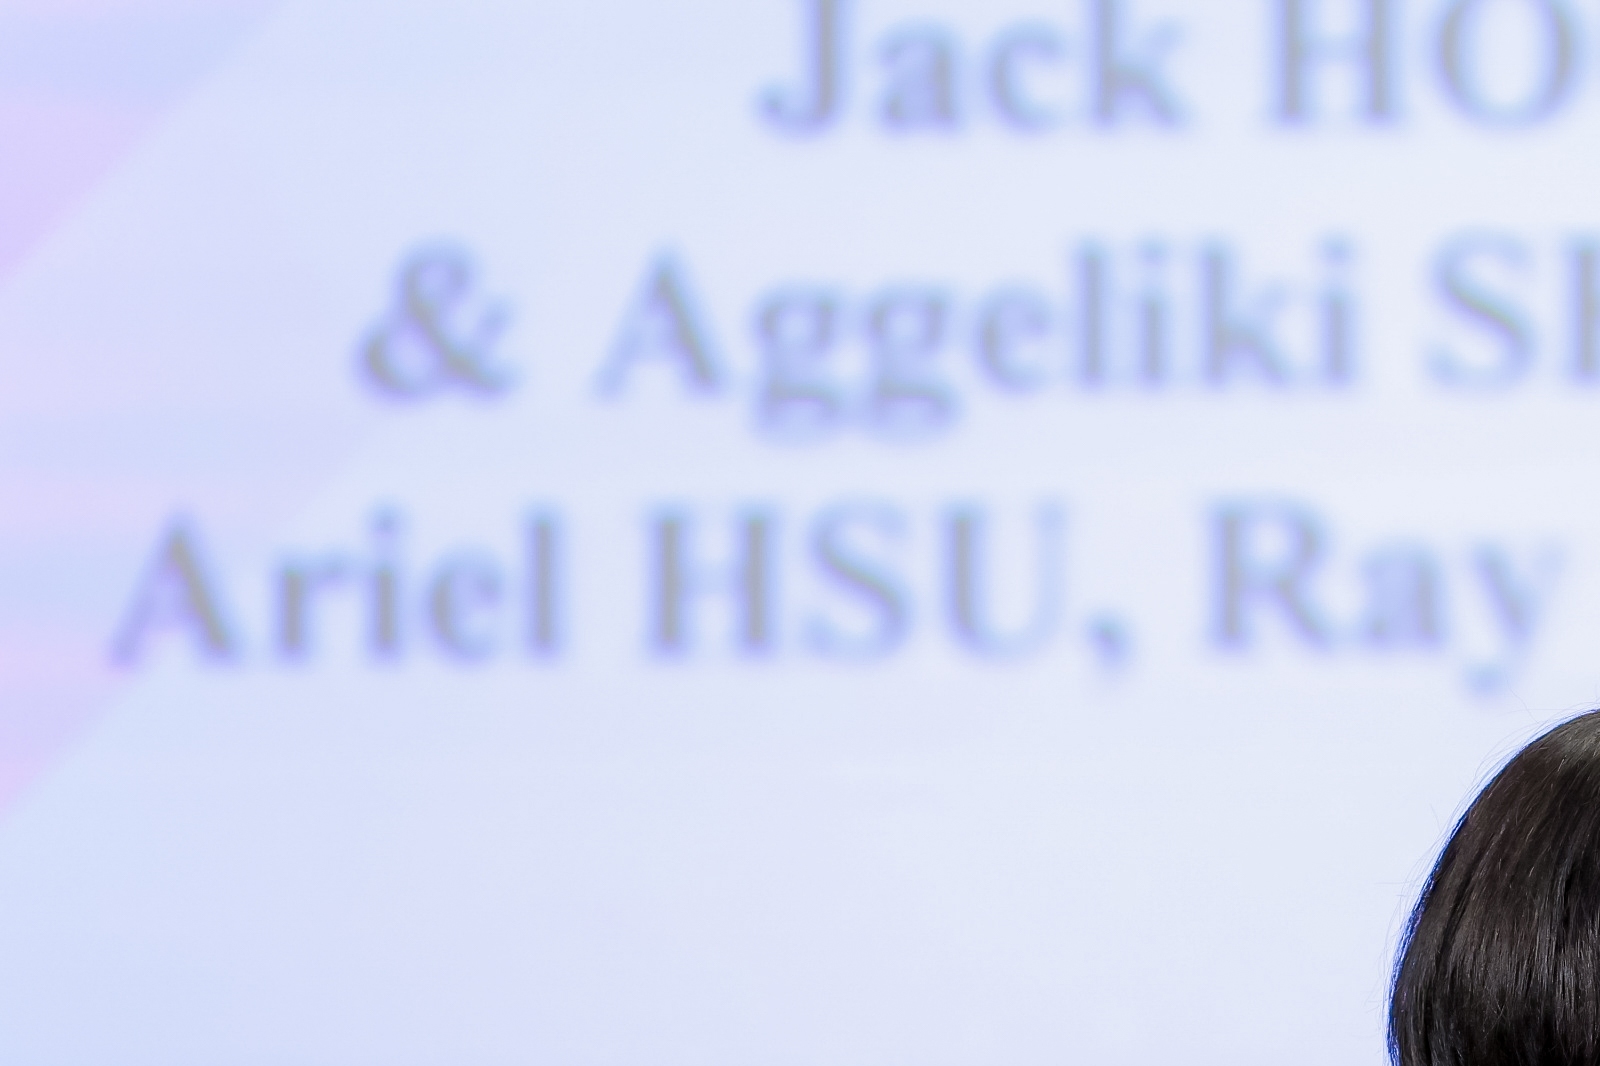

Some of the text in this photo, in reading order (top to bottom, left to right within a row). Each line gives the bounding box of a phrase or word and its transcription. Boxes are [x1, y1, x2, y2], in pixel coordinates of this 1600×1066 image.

[754, 0, 1188, 140] Jack
[352, 240, 518, 405] &
[593, 236, 1360, 446] Aggeliki
[112, 506, 567, 668] Ariel
[642, 499, 1132, 672] HSU,
[1204, 496, 1560, 700] Ray
